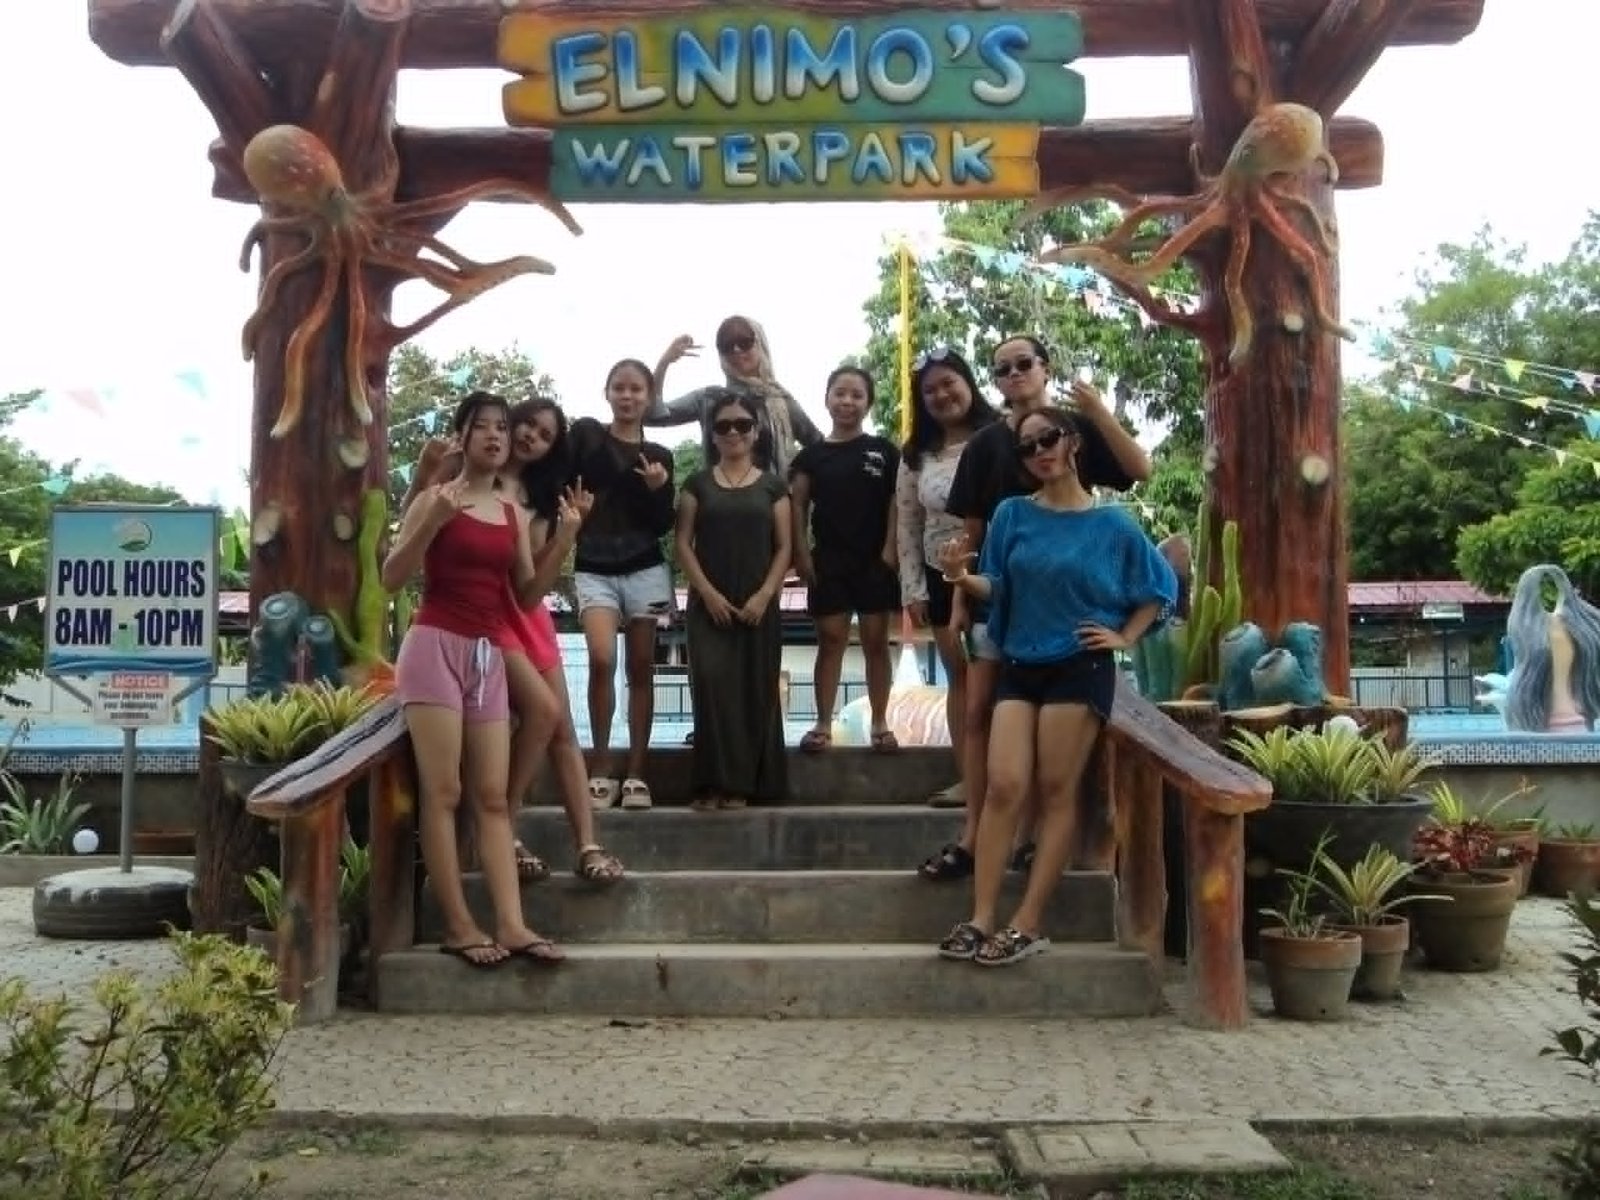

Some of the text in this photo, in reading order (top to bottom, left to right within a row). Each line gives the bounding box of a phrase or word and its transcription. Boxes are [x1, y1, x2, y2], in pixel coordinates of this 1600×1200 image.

[551, 24, 1031, 114] ELNIMO'S
[571, 130, 994, 188] WATERPARK
[57, 559, 206, 598] POOL HOURS
[55, 608, 204, 647] 8AM - 10PM
[114, 674, 165, 687] NOTICE
